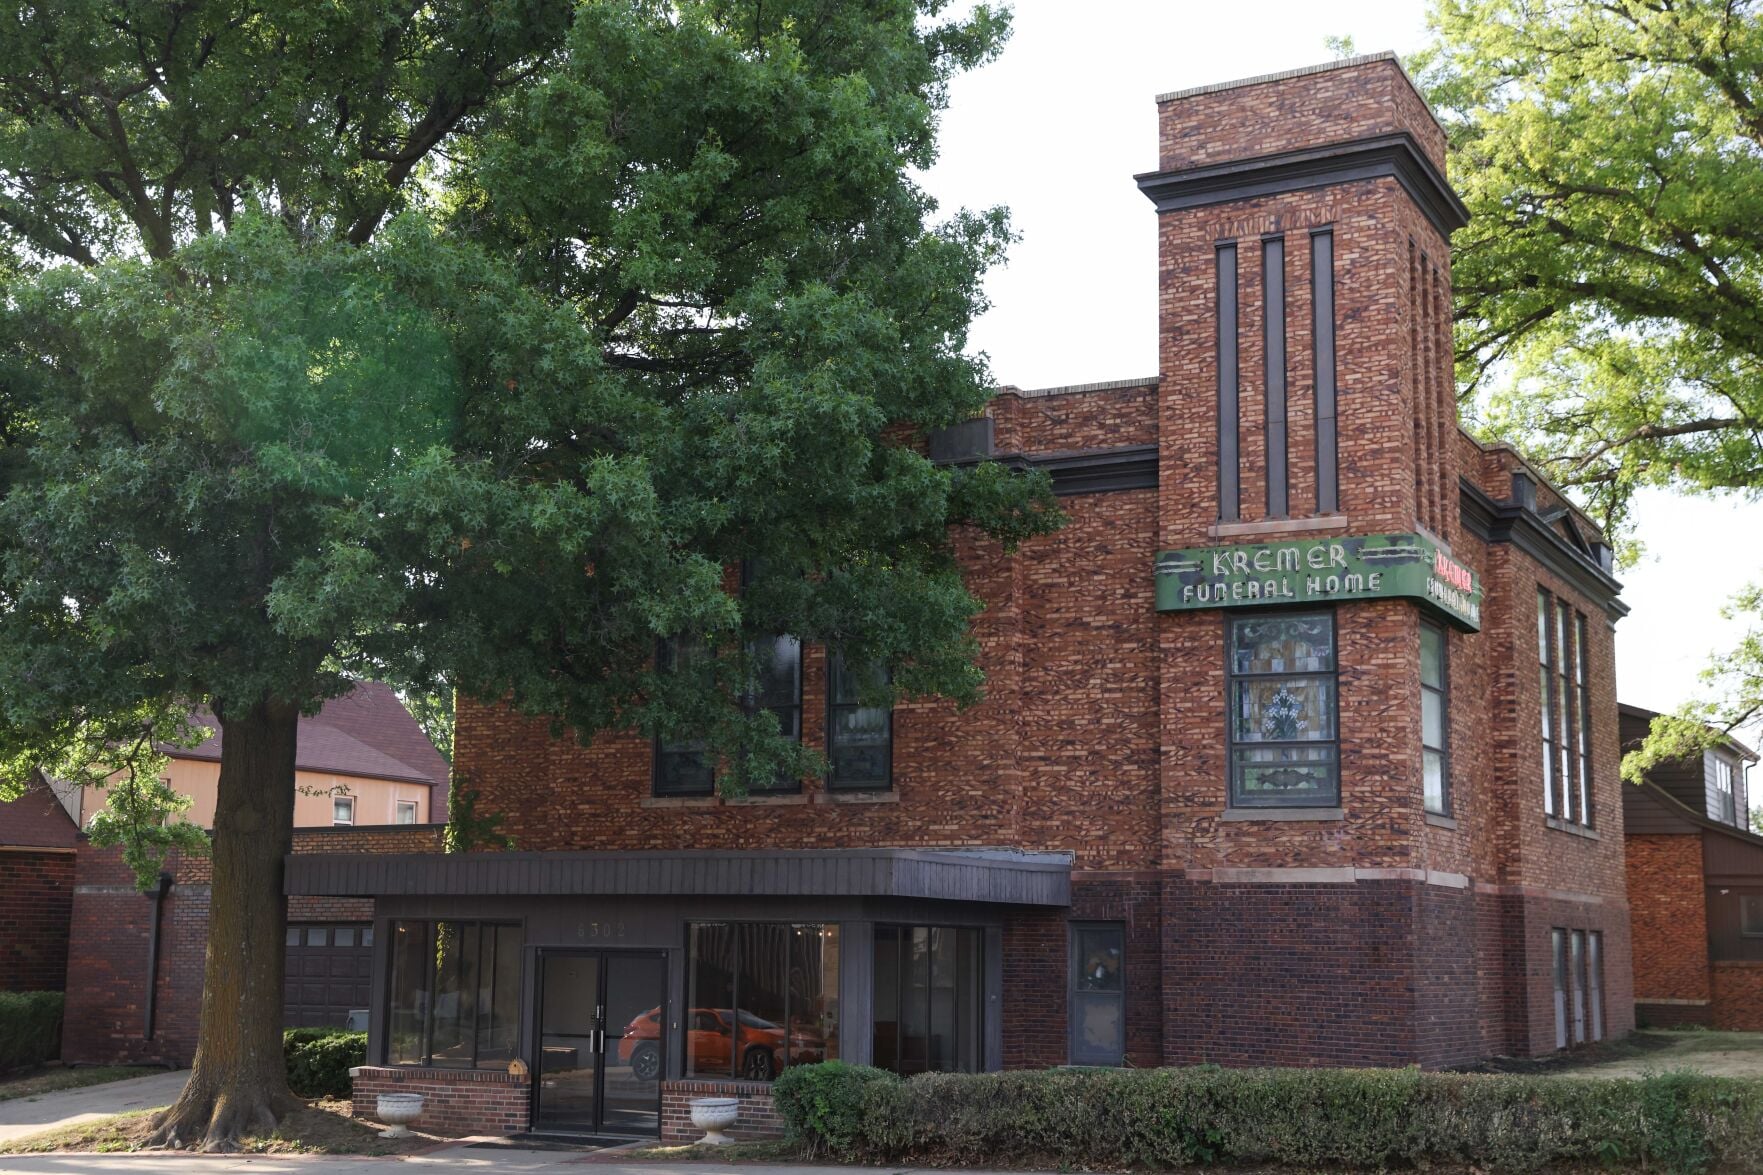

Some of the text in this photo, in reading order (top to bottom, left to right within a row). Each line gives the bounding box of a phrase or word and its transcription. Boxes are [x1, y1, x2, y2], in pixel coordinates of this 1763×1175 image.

[1212, 544, 1348, 575] KREMER
[1183, 573, 1382, 603] FUNERAL HOME
